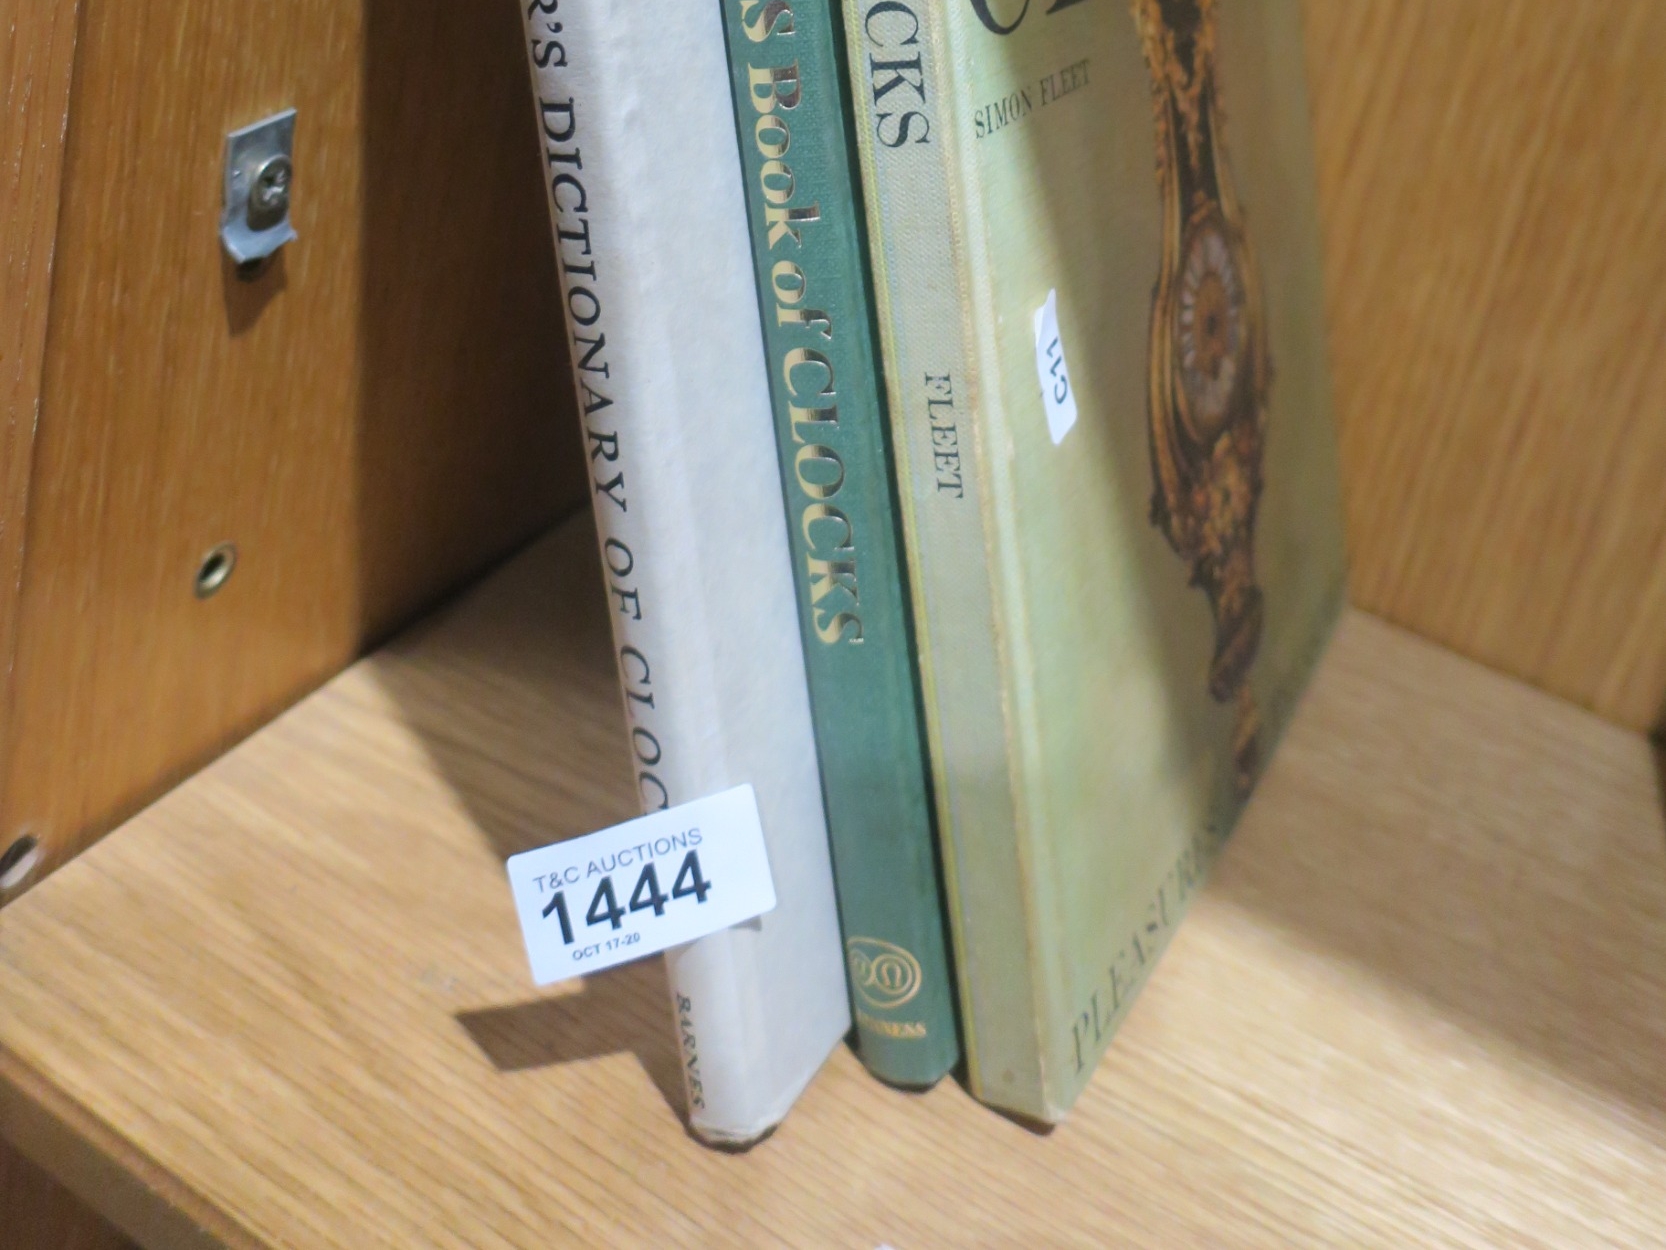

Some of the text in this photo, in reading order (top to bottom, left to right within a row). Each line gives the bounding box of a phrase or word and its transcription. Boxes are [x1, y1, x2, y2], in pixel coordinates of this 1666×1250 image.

[974, 57, 1092, 140] SIMON FLEET
[746, 61, 821, 251] Book
[538, 95, 629, 515] DICTIONARY
[772, 260, 833, 341] of
[924, 371, 965, 500] FLEET
[783, 347, 864, 645] CLOCKS
[604, 537, 642, 620] OF
[620, 645, 669, 814] CLOC
[532, 827, 704, 894] T&C AUCTIONS
[541, 849, 713, 946] 1444
[572, 932, 641, 962] OCT 17-20
[676, 991, 705, 1111] BARNES
